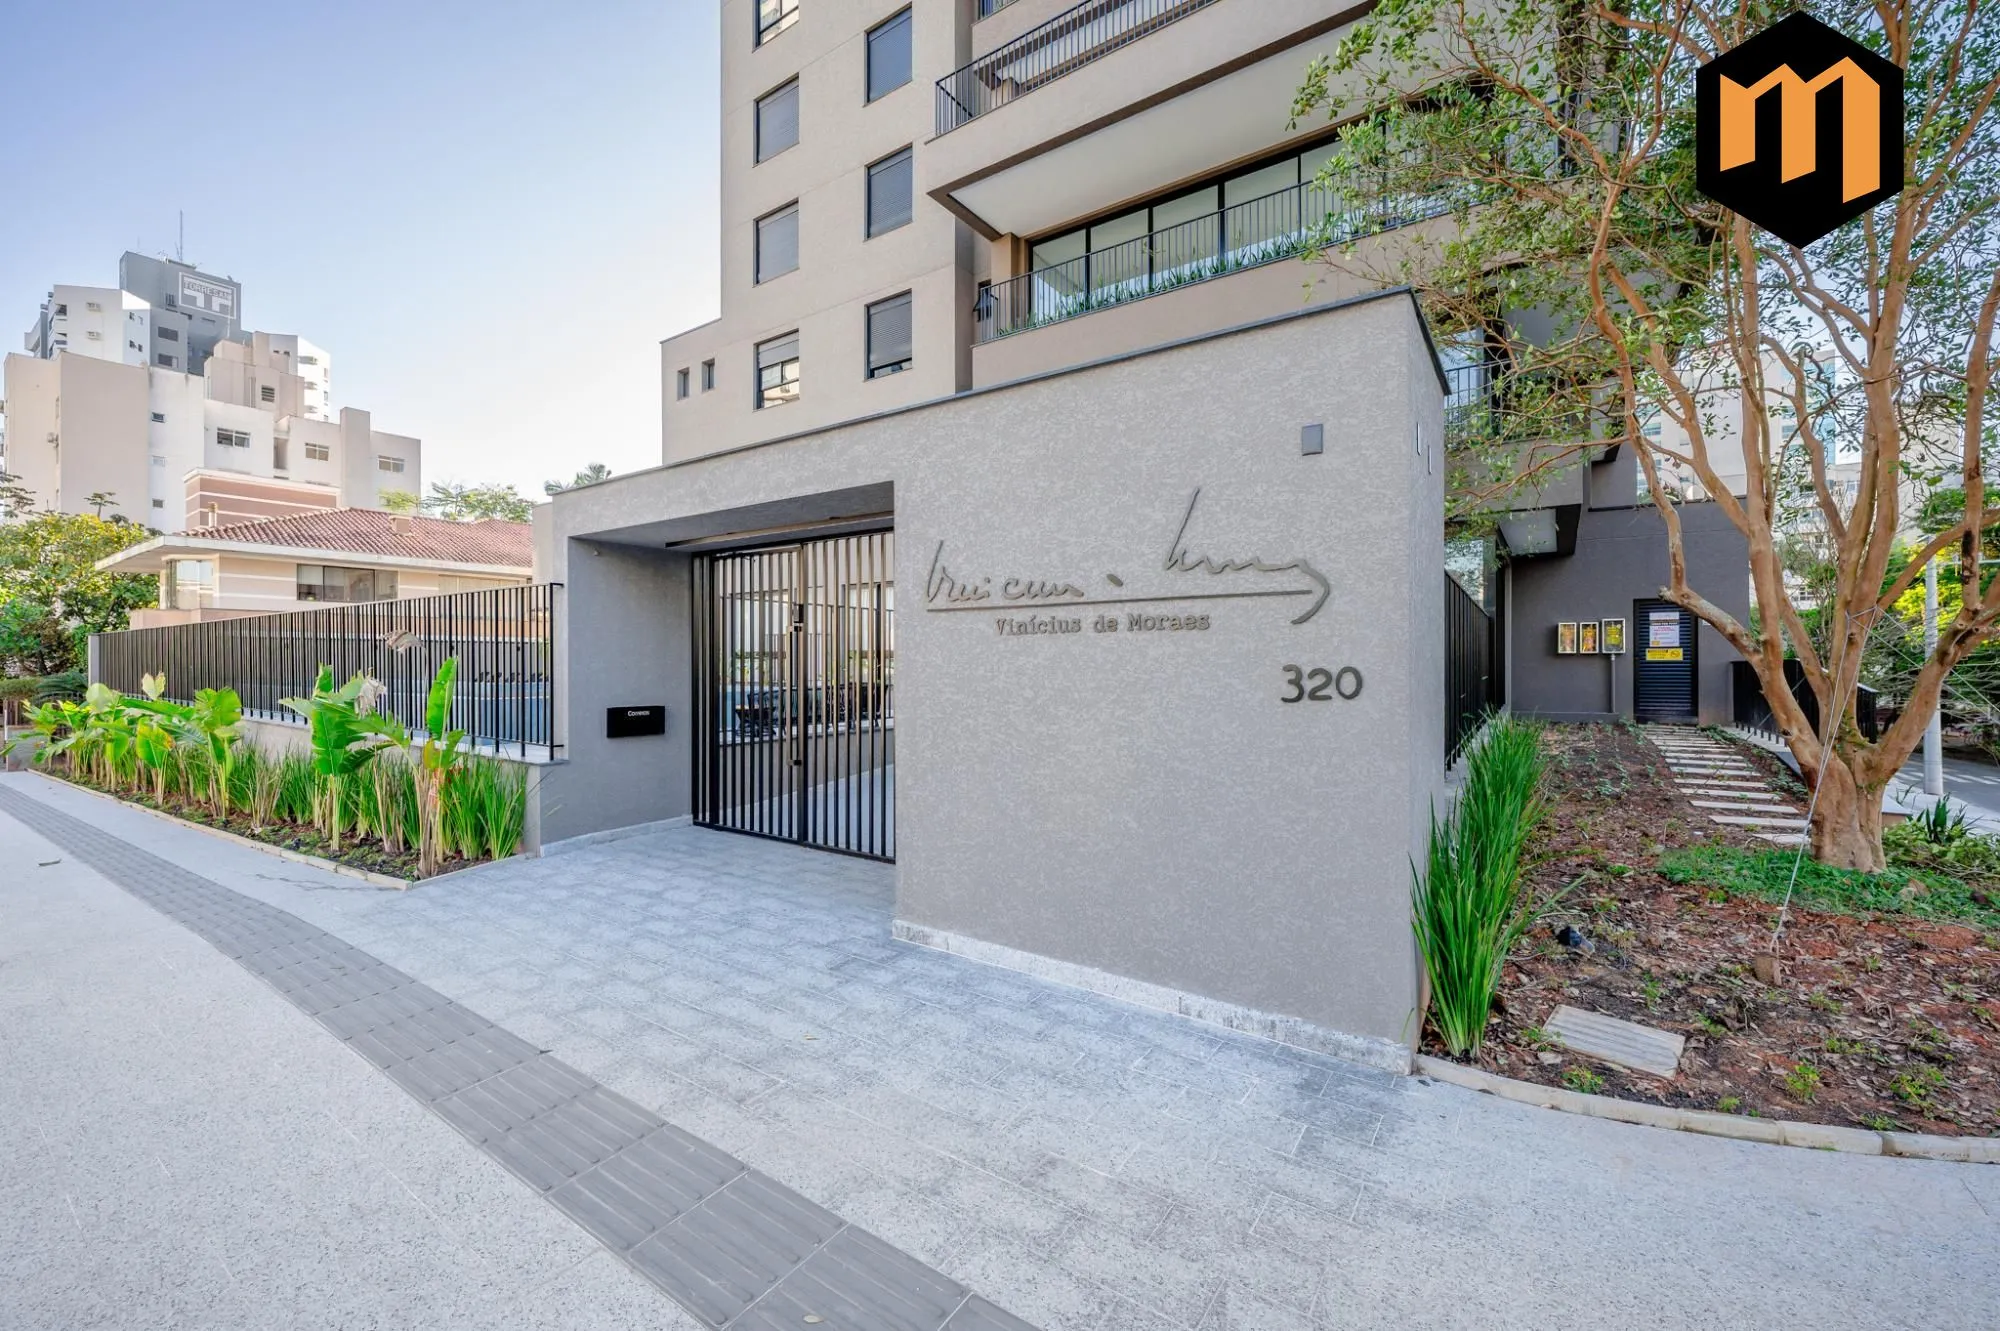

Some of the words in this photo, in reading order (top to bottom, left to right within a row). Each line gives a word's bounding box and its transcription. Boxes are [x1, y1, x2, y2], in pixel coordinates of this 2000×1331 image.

[996, 613, 1081, 636] Vinícius
[1094, 612, 1118, 632] de
[1127, 611, 1211, 632] Moraes
[1281, 664, 1363, 703] 320
